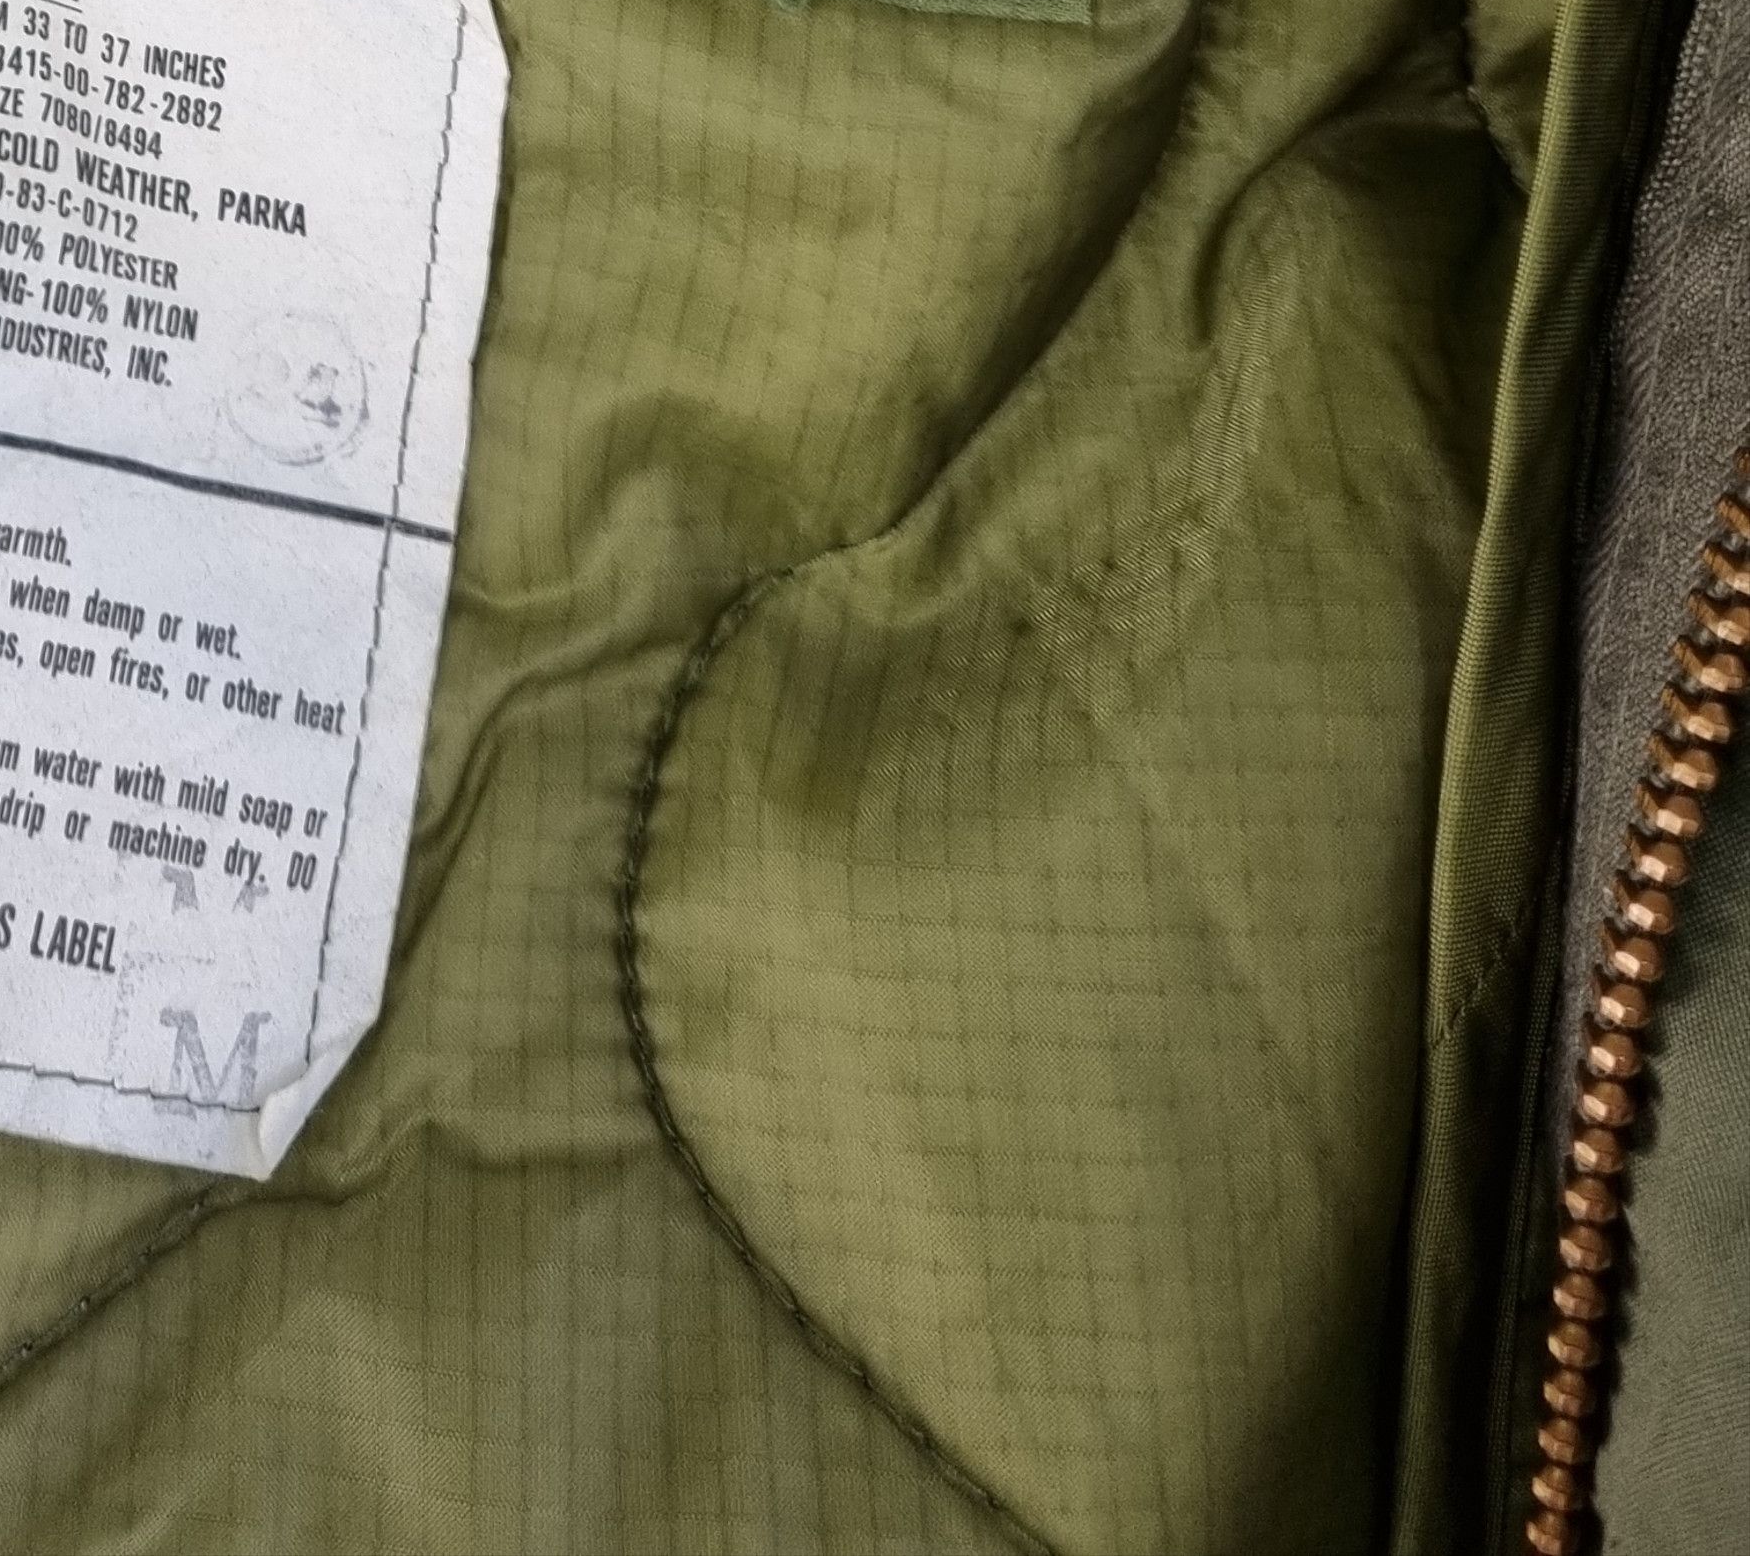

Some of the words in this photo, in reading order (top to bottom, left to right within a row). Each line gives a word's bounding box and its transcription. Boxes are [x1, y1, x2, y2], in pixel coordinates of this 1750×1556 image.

[23, 6, 50, 41] 33
[63, 18, 88, 55] TO
[100, 32, 131, 68] 37
[143, 44, 227, 90] INCHES
[40, 92, 163, 160] 7080/8494
[75, 148, 199, 223] WEATHER,
[217, 187, 307, 238] PARKA
[126, 345, 172, 388] INC.
[9, 575, 71, 618] when
[83, 588, 146, 641] damp
[158, 612, 183, 643] or
[196, 621, 241, 660] wet.
[39, 640, 96, 679] open
[109, 647, 169, 701] fires,
[185, 672, 211, 703] or
[222, 678, 283, 721] other
[294, 688, 346, 737] heat
[29, 910, 116, 975] LABEL
